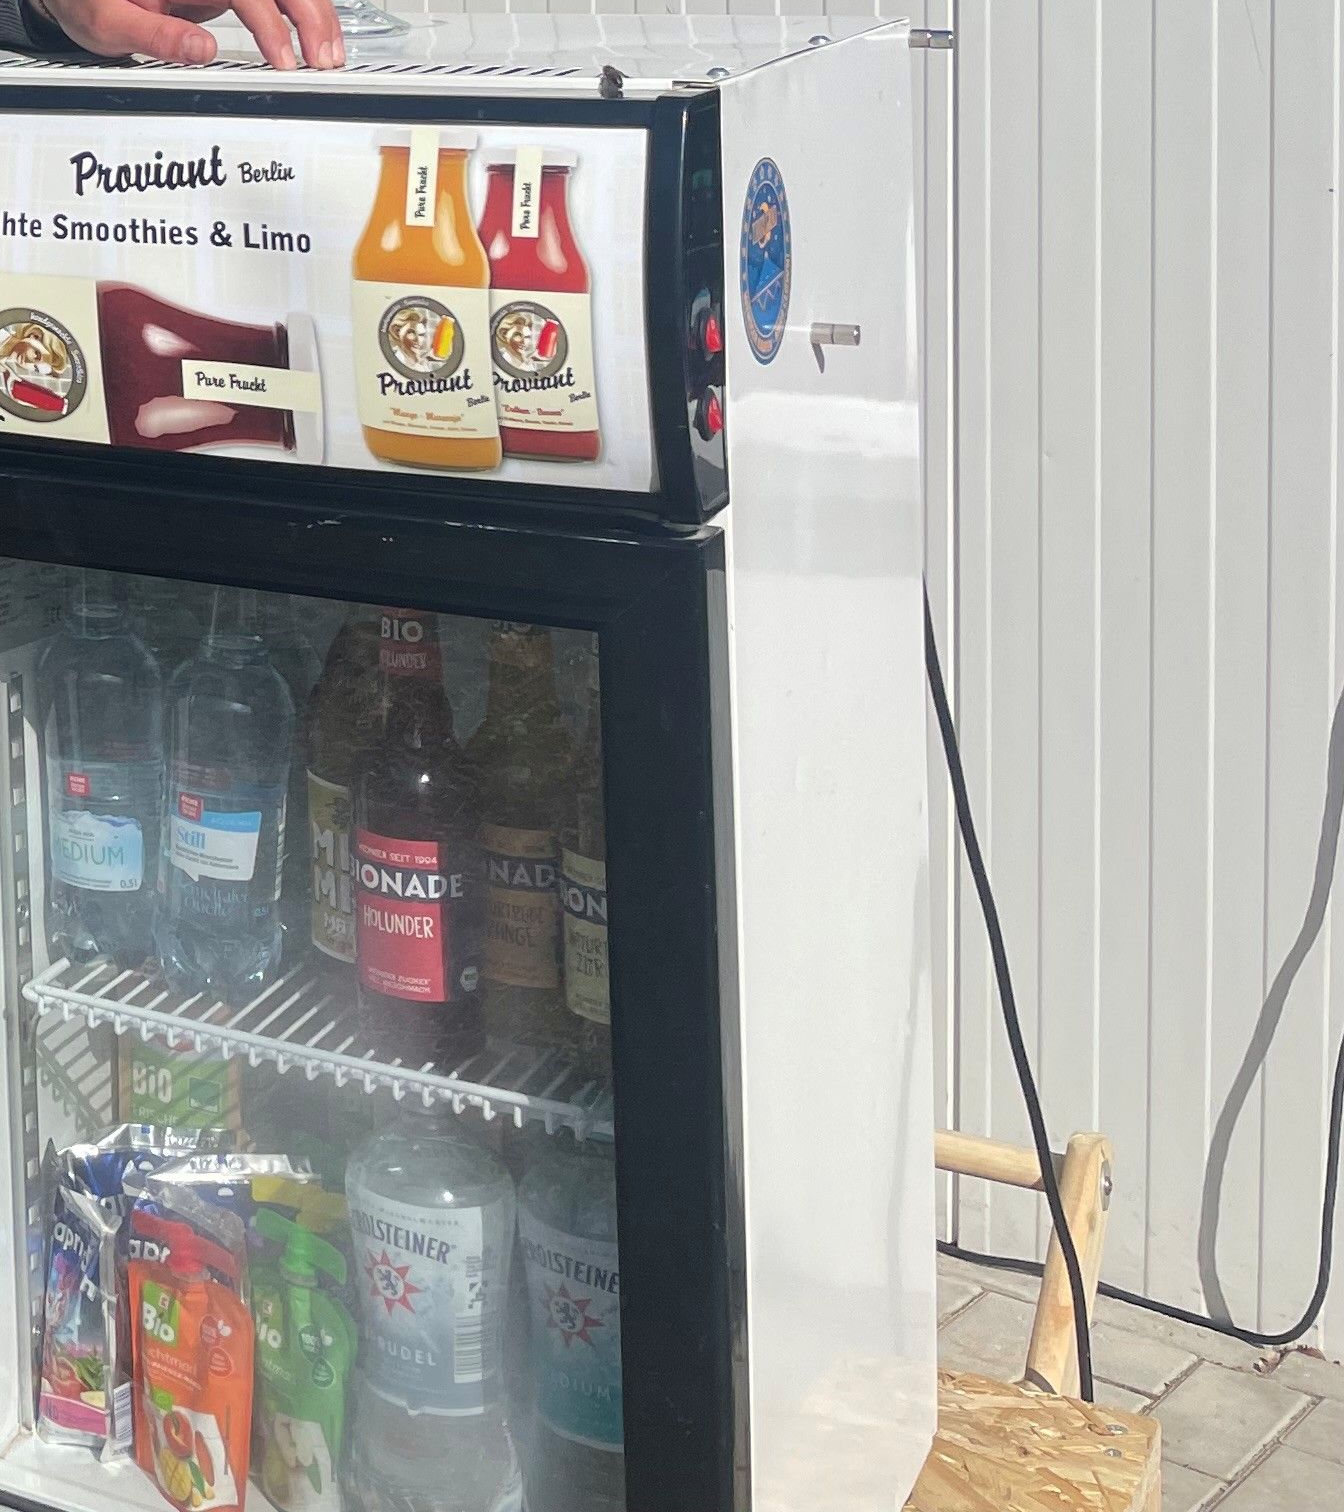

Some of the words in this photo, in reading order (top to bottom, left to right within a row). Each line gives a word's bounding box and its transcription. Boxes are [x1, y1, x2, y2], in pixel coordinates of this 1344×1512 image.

[69, 146, 227, 197] Proviant
[238, 160, 296, 184] Berlin
[52, 214, 199, 246] Smoothies
[210, 221, 233, 248] &
[243, 222, 312, 254] Limo
[195, 371, 226, 389] Pure
[229, 373, 268, 393] Frucht
[377, 368, 474, 396] Proviant
[381, 617, 423, 642] BIO
[390, 852, 412, 864] SEIT
[363, 904, 434, 939] HOLUNDER
